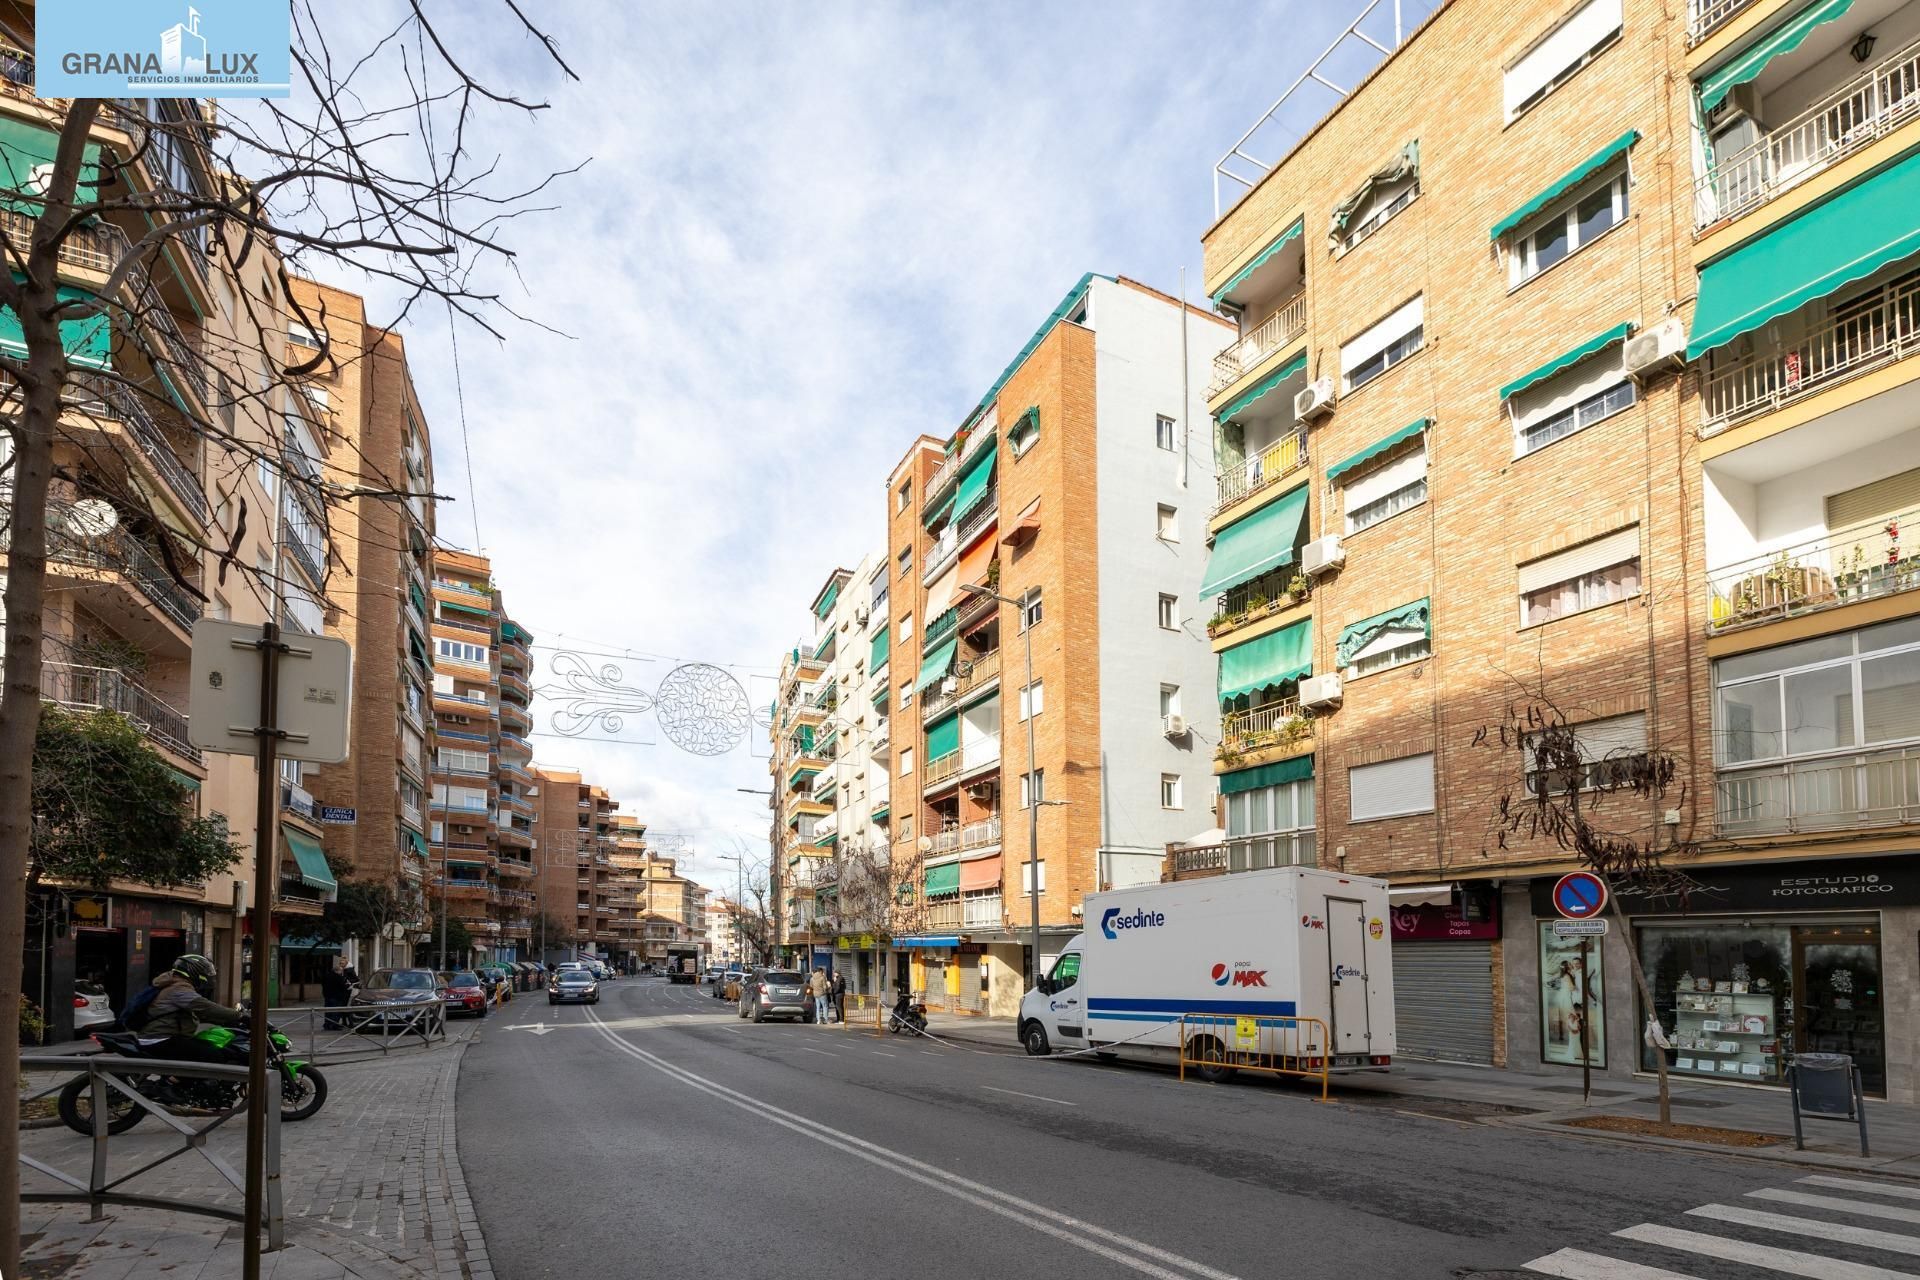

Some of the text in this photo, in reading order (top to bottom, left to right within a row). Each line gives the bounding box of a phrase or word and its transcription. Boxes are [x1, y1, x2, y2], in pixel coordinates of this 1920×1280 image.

[1780, 874, 1880, 886] ESTUDIO
[1771, 884, 1894, 897] FOTOGRAFICO
[1116, 907, 1165, 930] sedinte
[1449, 920, 1470, 928] Tapas
[1448, 928, 1472, 937] Copas
[1234, 961, 1251, 969] pepsi
[1232, 970, 1269, 988] MAX
